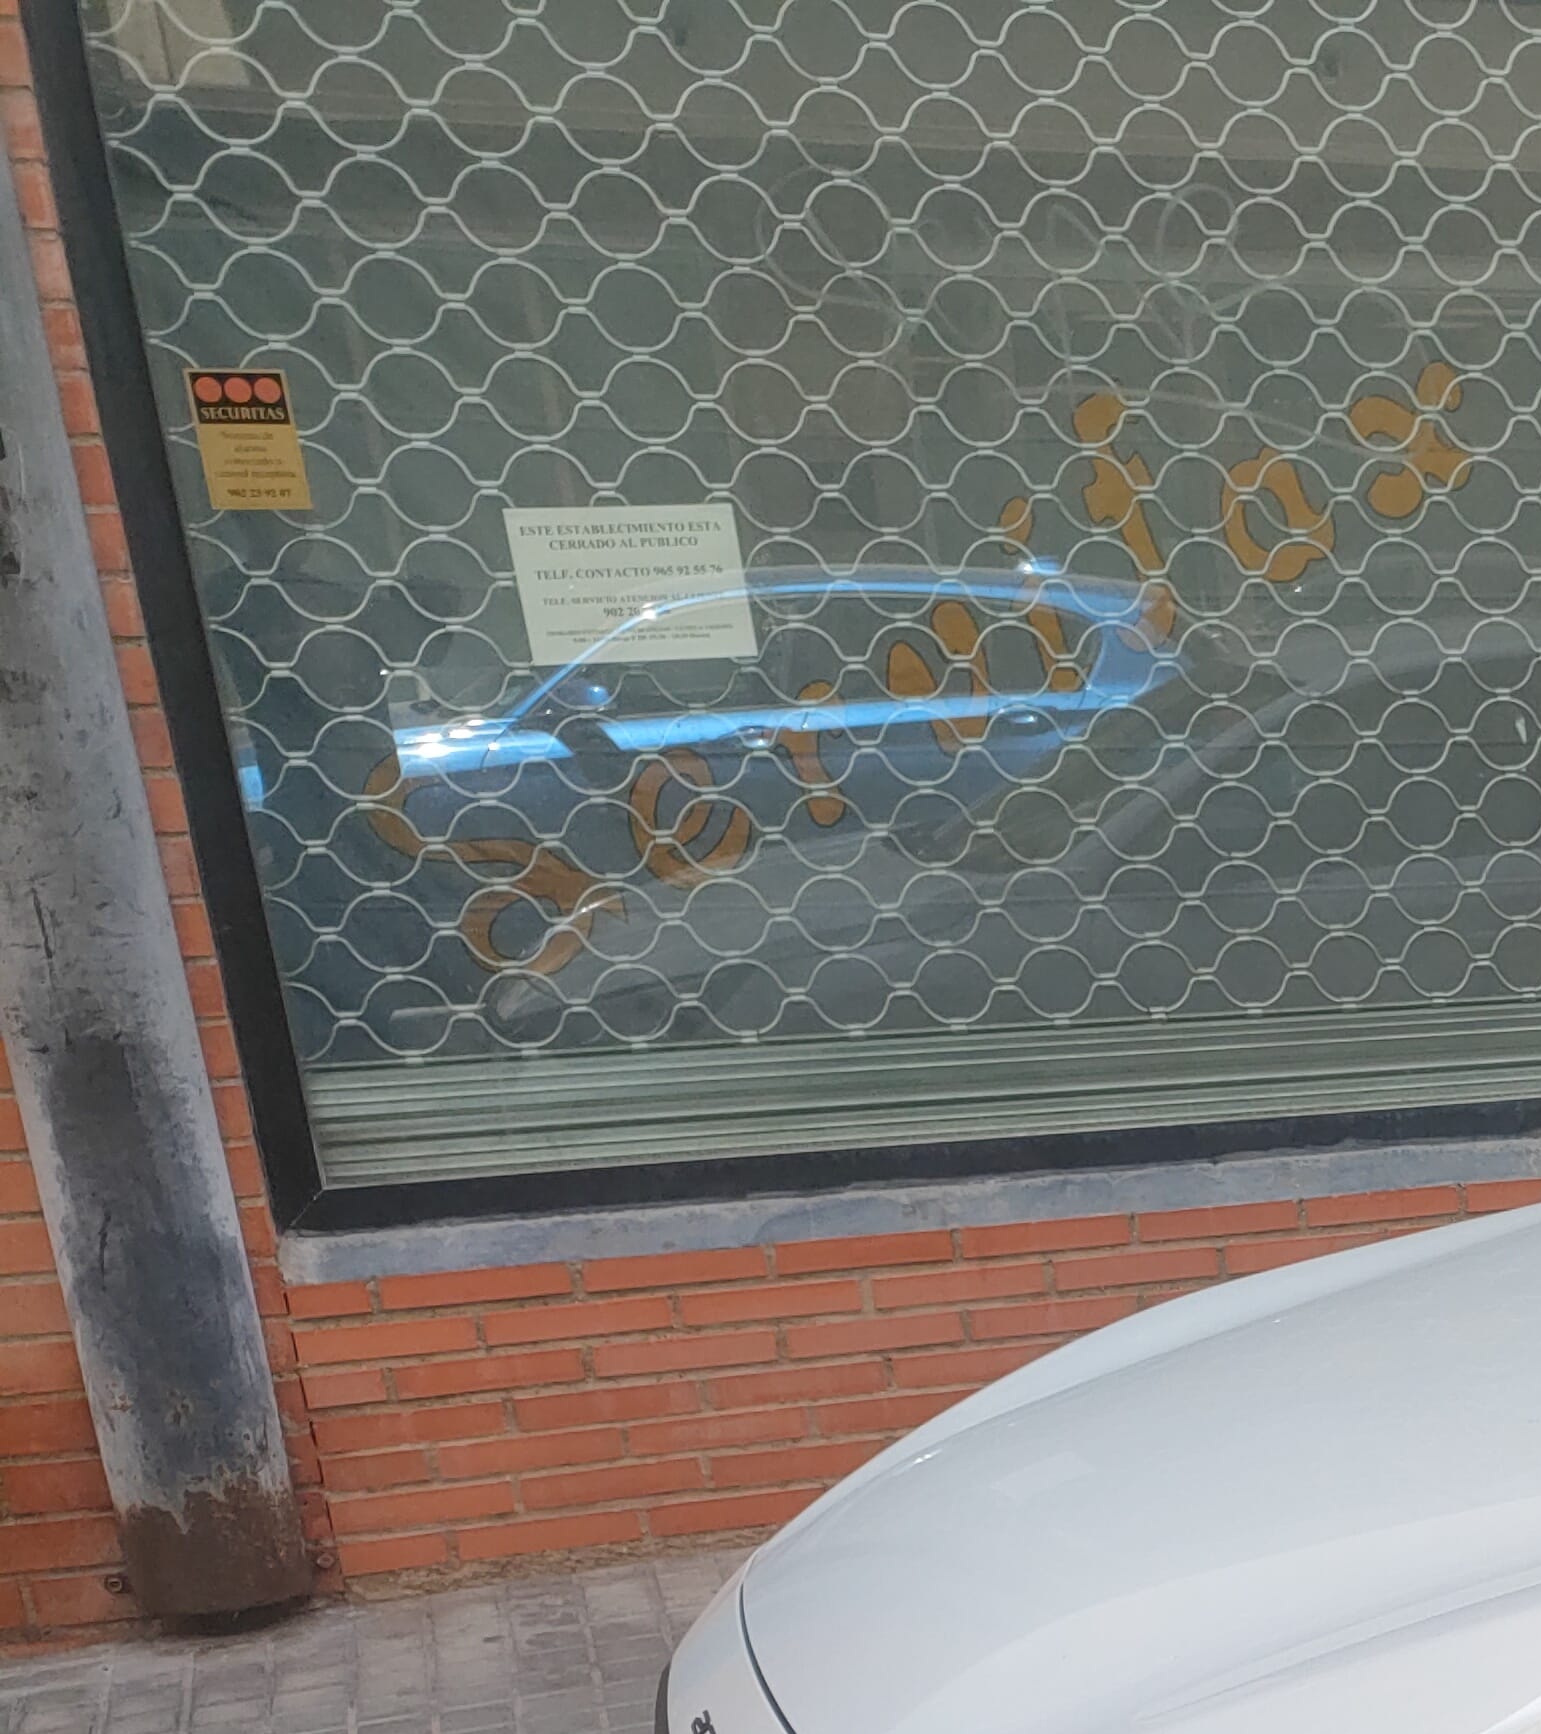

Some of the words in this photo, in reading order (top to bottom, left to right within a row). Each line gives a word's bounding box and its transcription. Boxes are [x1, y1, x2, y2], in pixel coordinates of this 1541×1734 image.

[201, 405, 285, 420] SECURITAS
[520, 525, 551, 537] ESTE
[557, 522, 685, 535] ESTABLECIMIENTO
[689, 521, 721, 532] ESTA
[549, 538, 616, 550] CERRADO
[619, 538, 635, 549] AL
[640, 536, 698, 547] PUBLICO
[535, 569, 573, 580] TELF.
[576, 567, 650, 579] CONTACTO
[653, 566, 673, 576] 965
[676, 565, 689, 575] 92
[693, 564, 706, 574] 55
[709, 564, 723, 574] 76
[603, 608, 624, 617] 902
